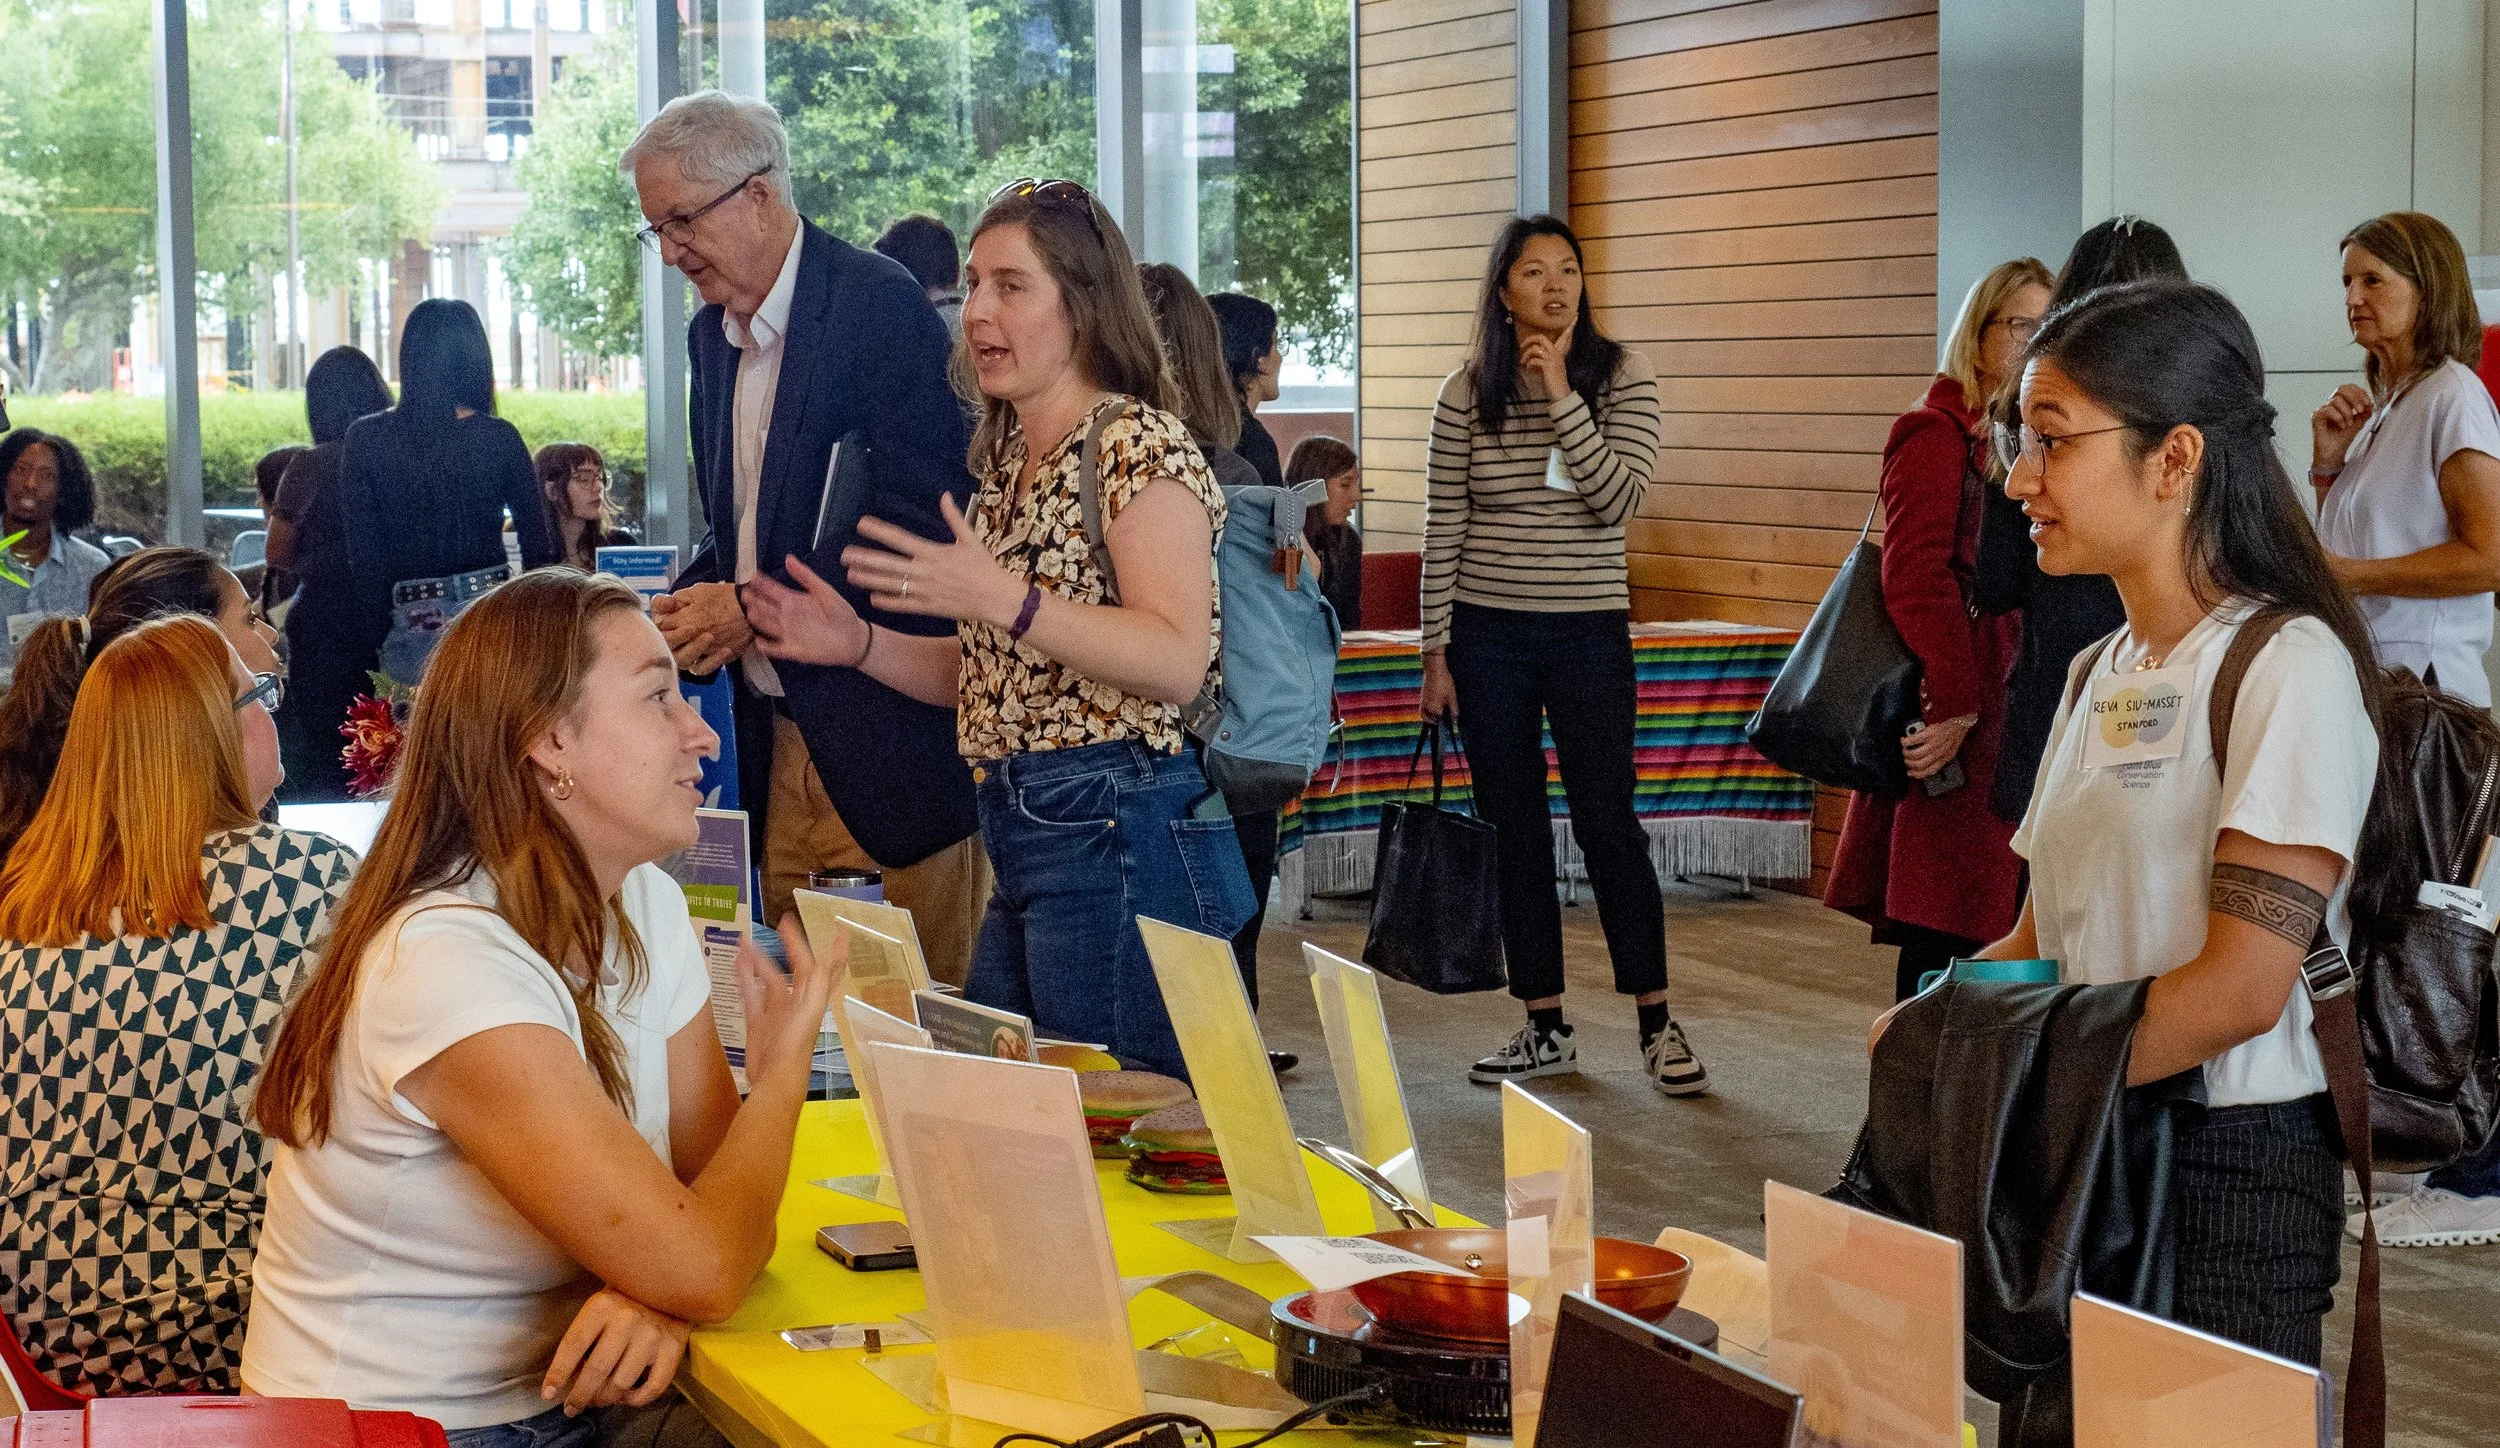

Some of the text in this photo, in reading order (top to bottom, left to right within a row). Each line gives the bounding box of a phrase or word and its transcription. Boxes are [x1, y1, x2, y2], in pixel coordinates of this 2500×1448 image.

[613, 556, 628, 565] Stay
[2093, 695, 2183, 713] REVA SIU-MASSET
[2117, 718, 2158, 731] STANFORD
[2144, 760, 2162, 769] Blue
[2116, 770, 2165, 779] Conservation
[712, 898, 733, 909] THRIVE
